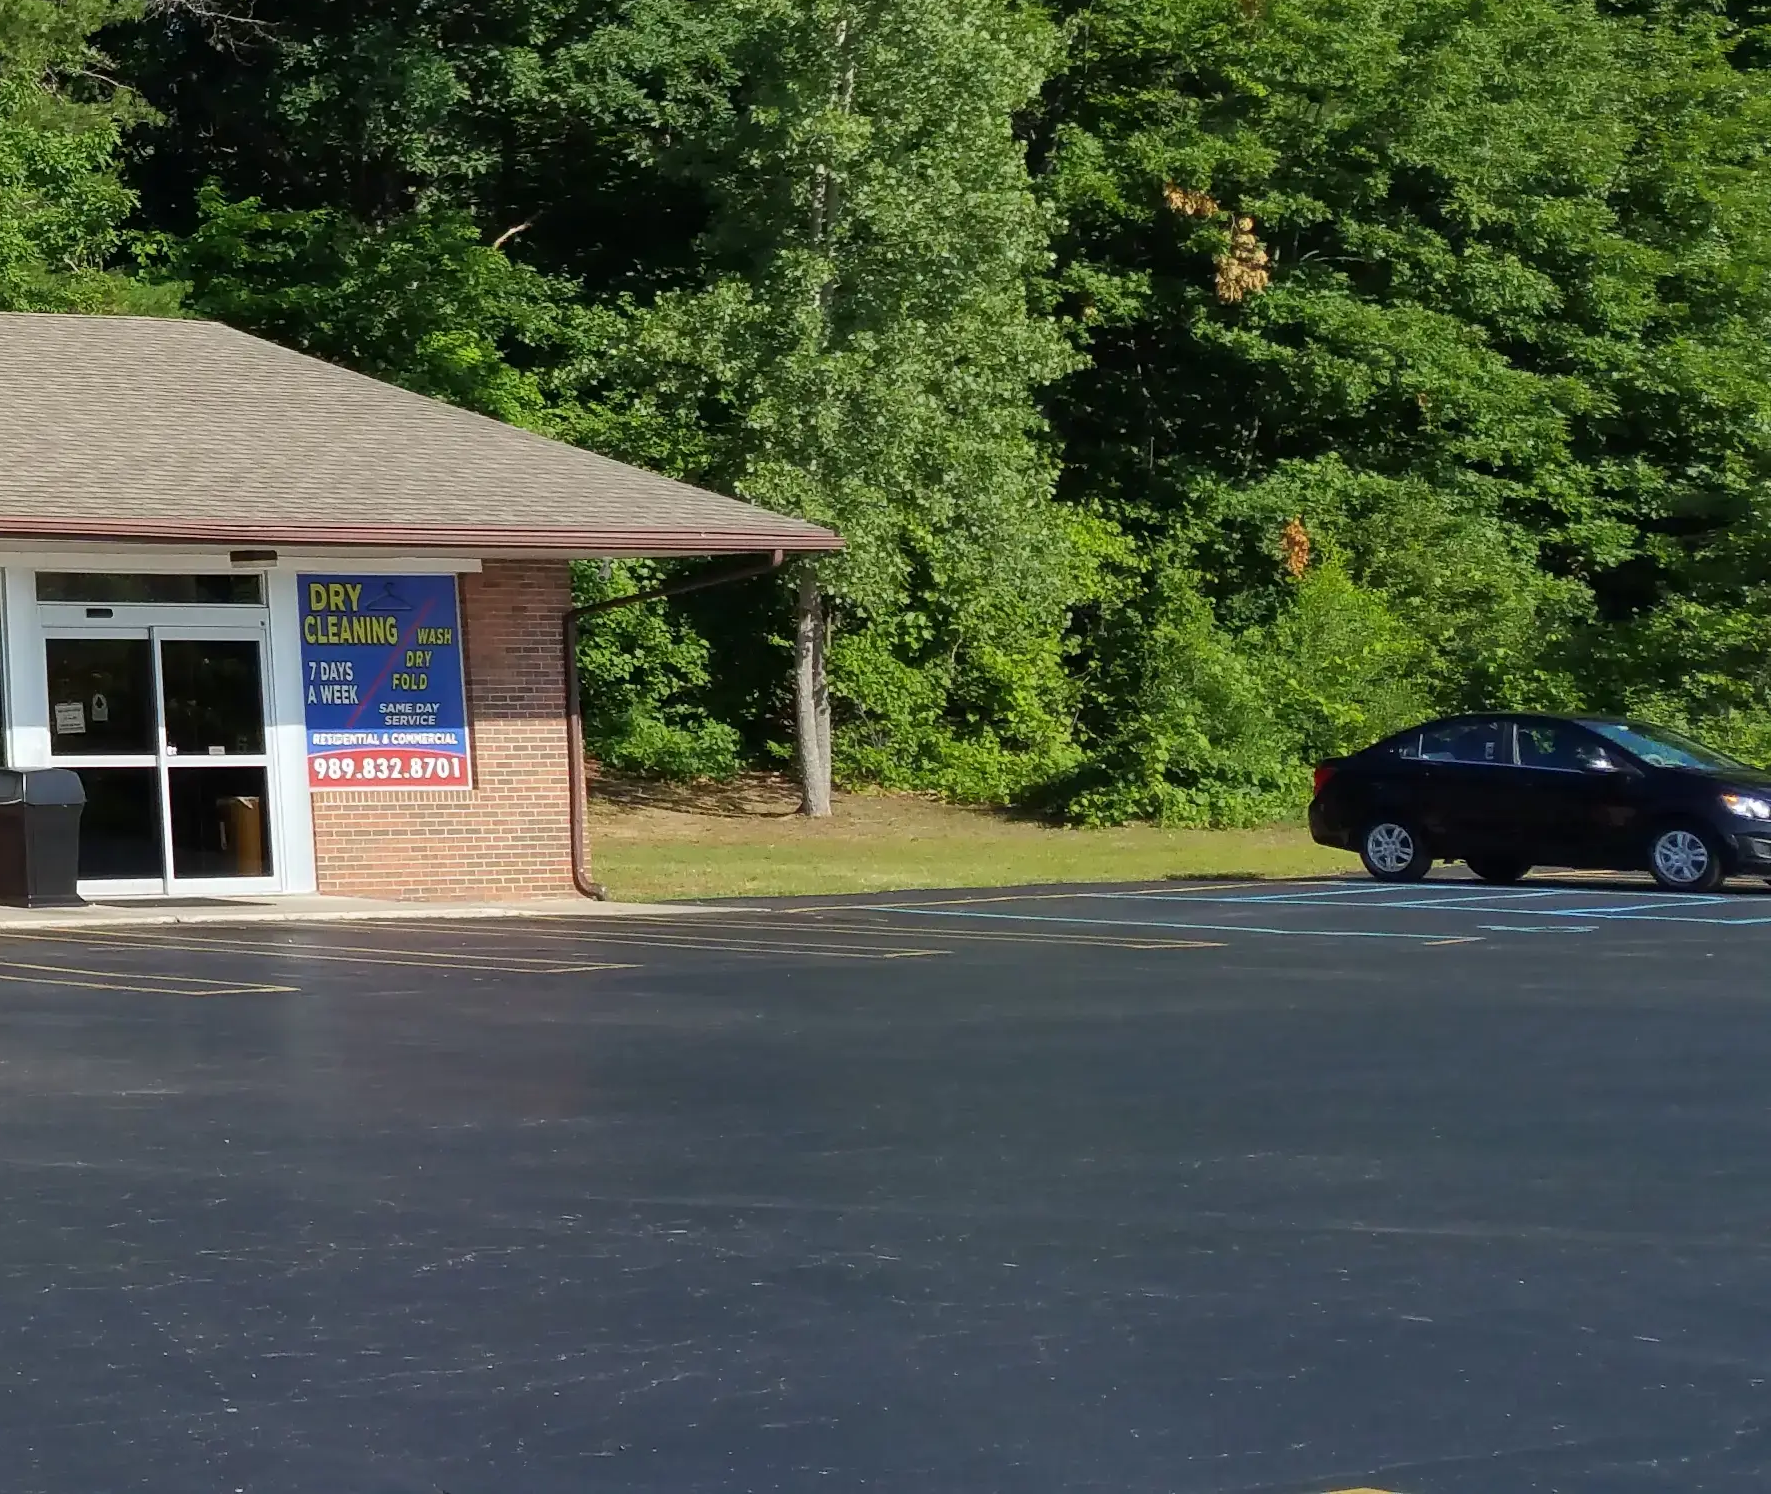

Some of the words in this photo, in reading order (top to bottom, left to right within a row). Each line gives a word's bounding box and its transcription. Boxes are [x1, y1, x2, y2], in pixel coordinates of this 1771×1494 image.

[309, 583, 362, 611] DRY
[304, 615, 398, 645] CLEANING
[417, 628, 452, 645] WASH
[406, 650, 432, 667] DRY
[309, 662, 317, 681] 7
[320, 662, 353, 681] DAYS
[392, 673, 428, 690] FOLD
[307, 686, 317, 704] A
[320, 685, 359, 704] WEEK
[379, 703, 413, 713] SAME
[416, 703, 440, 713] DAY
[385, 715, 436, 725] SERVICE
[313, 733, 380, 746] RESIDENTIAL
[381, 733, 389, 745] &
[391, 733, 458, 745] COMMERCIAL
[314, 757, 461, 779] 989.832.8701
